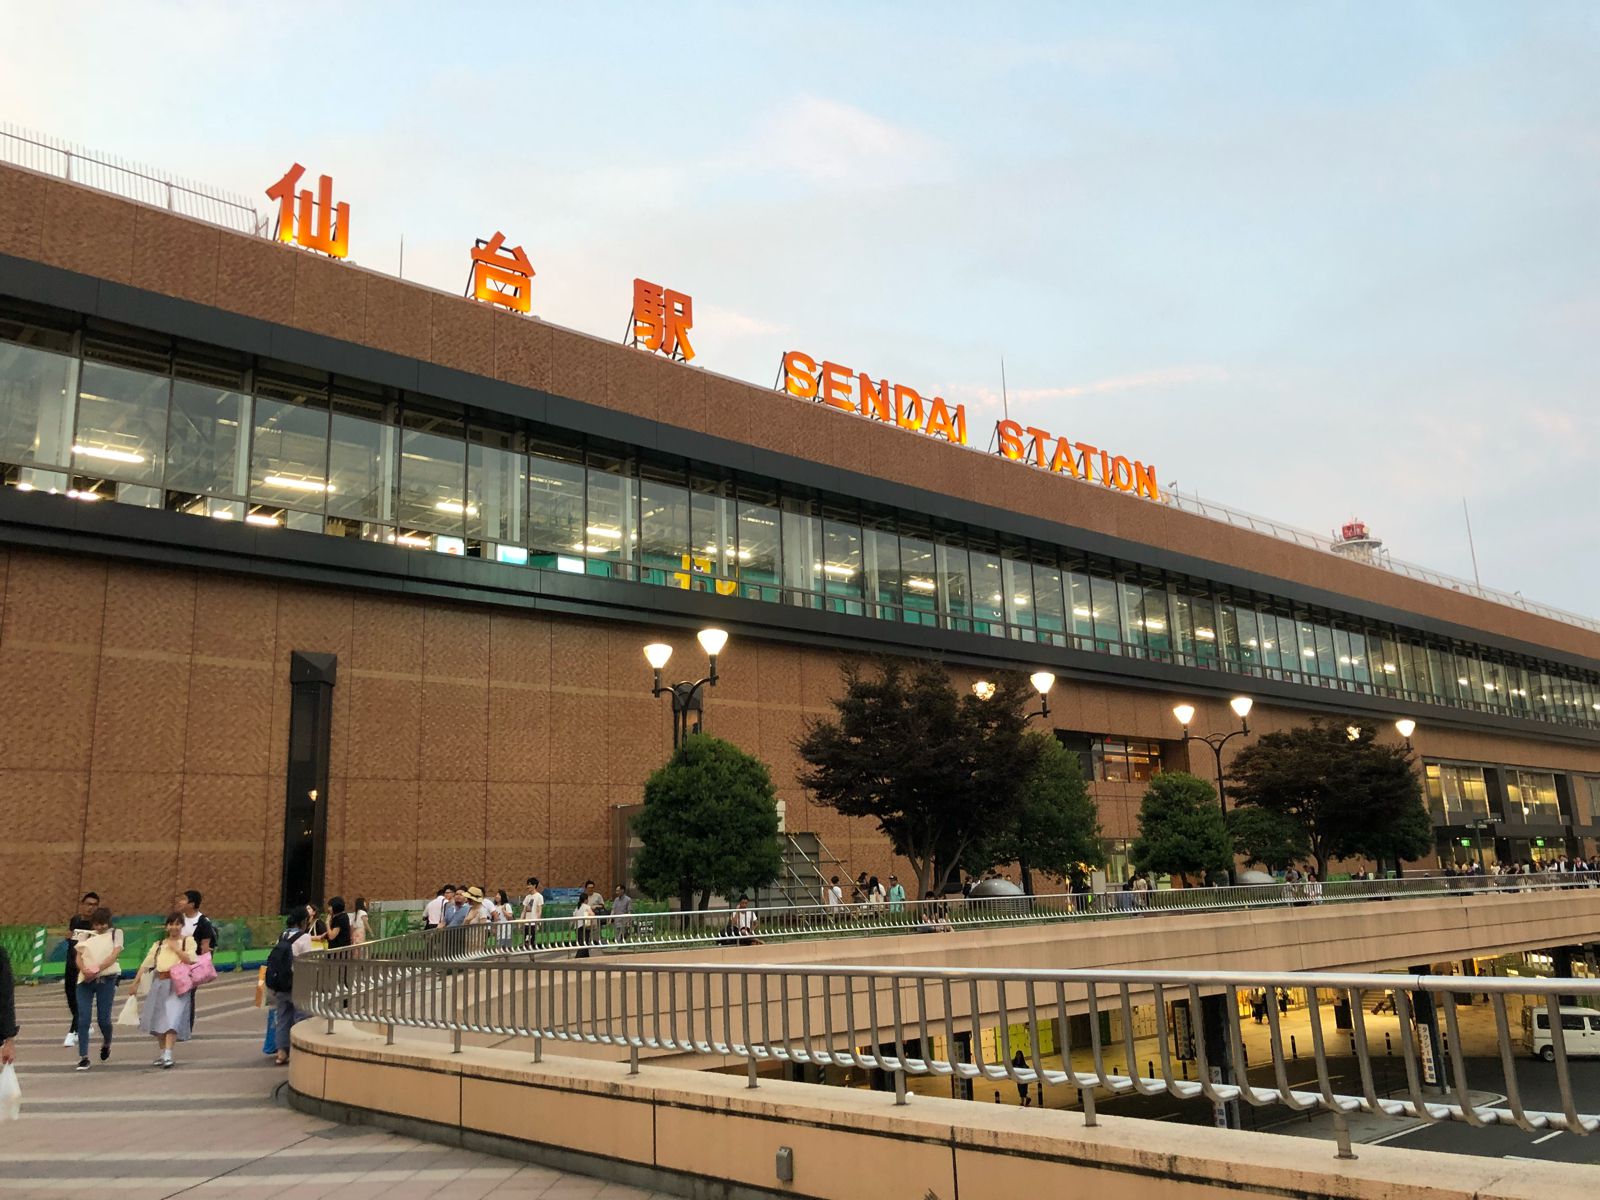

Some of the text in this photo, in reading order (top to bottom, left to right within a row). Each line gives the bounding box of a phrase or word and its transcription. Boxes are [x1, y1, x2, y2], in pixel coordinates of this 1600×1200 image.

[265, 162, 696, 361] 仙台駅
[784, 351, 1159, 500] SENDAI STATION
